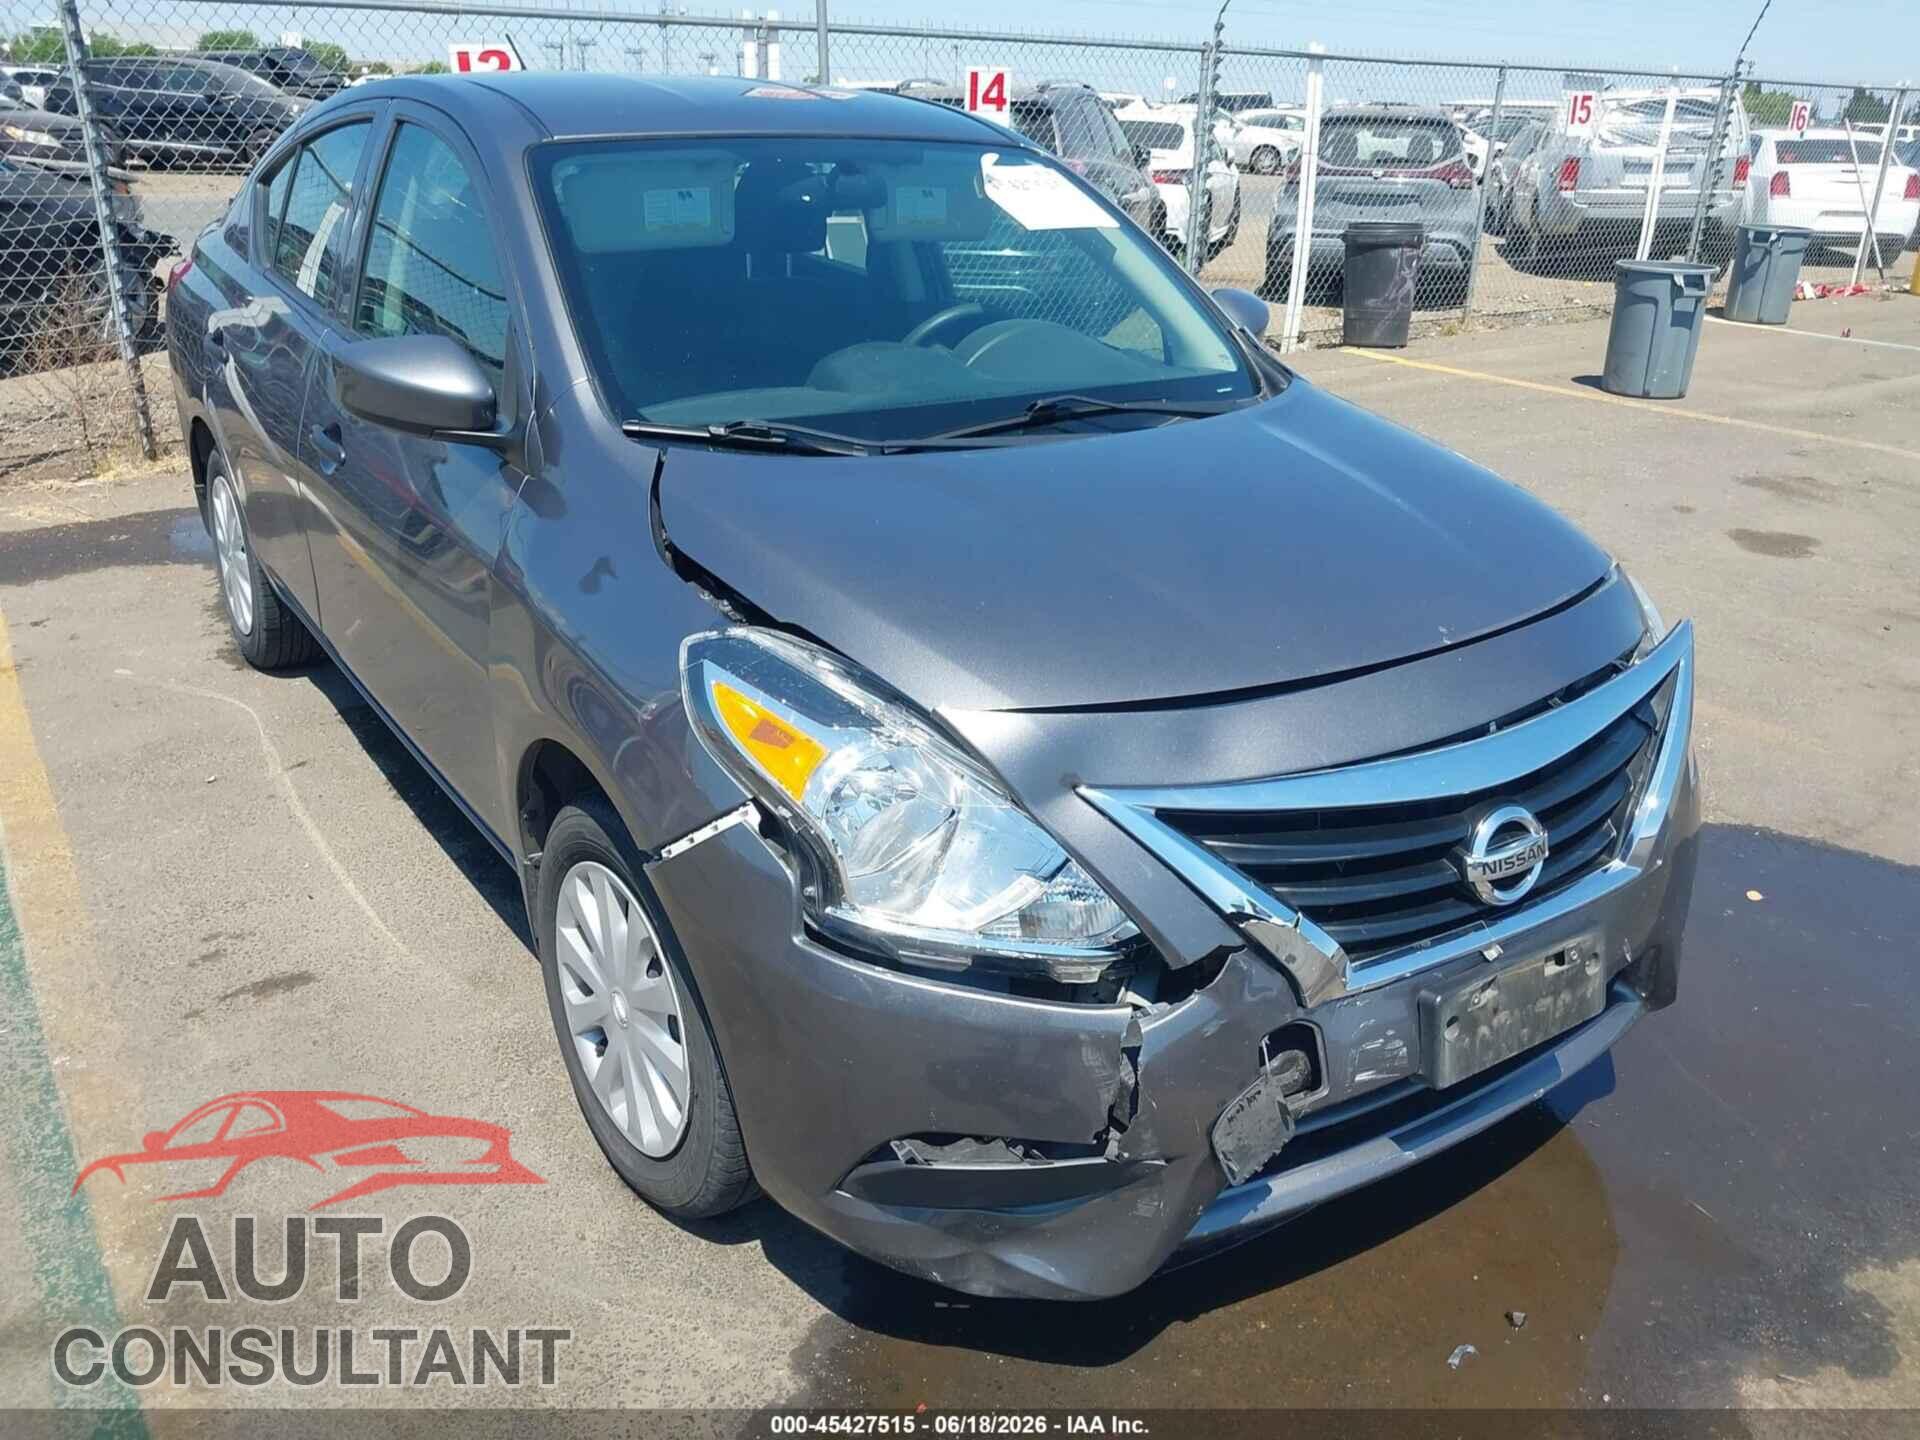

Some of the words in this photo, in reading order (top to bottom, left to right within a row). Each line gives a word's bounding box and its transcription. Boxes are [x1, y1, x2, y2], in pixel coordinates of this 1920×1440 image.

[970, 71, 1007, 111] 14
[1570, 95, 1593, 124] 15
[1790, 104, 1807, 131] 16
[1482, 842, 1546, 875] NISSAN
